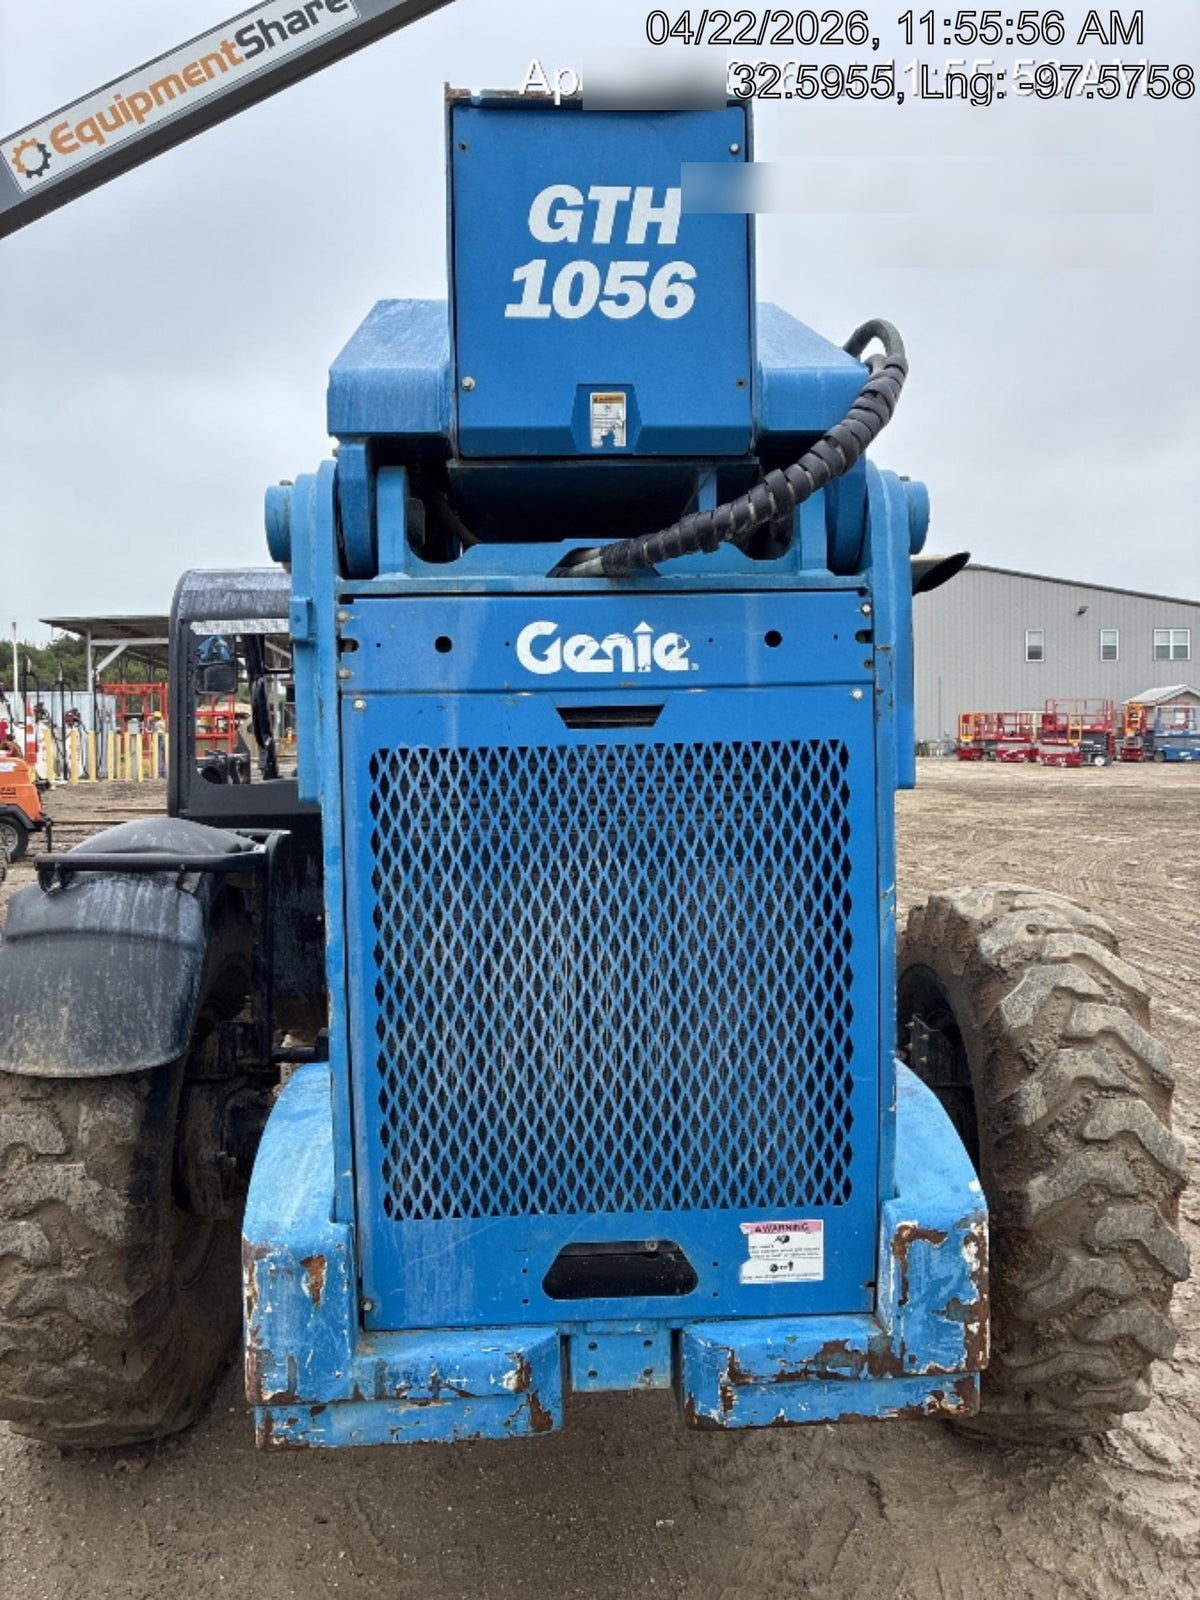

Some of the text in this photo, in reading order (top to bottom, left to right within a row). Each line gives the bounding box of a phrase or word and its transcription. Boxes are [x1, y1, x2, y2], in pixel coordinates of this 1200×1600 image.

[528, 184, 681, 244] GTH
[504, 259, 697, 319] 1056
[516, 621, 691, 675] Genie
[762, 1222, 809, 1233] WARNING
